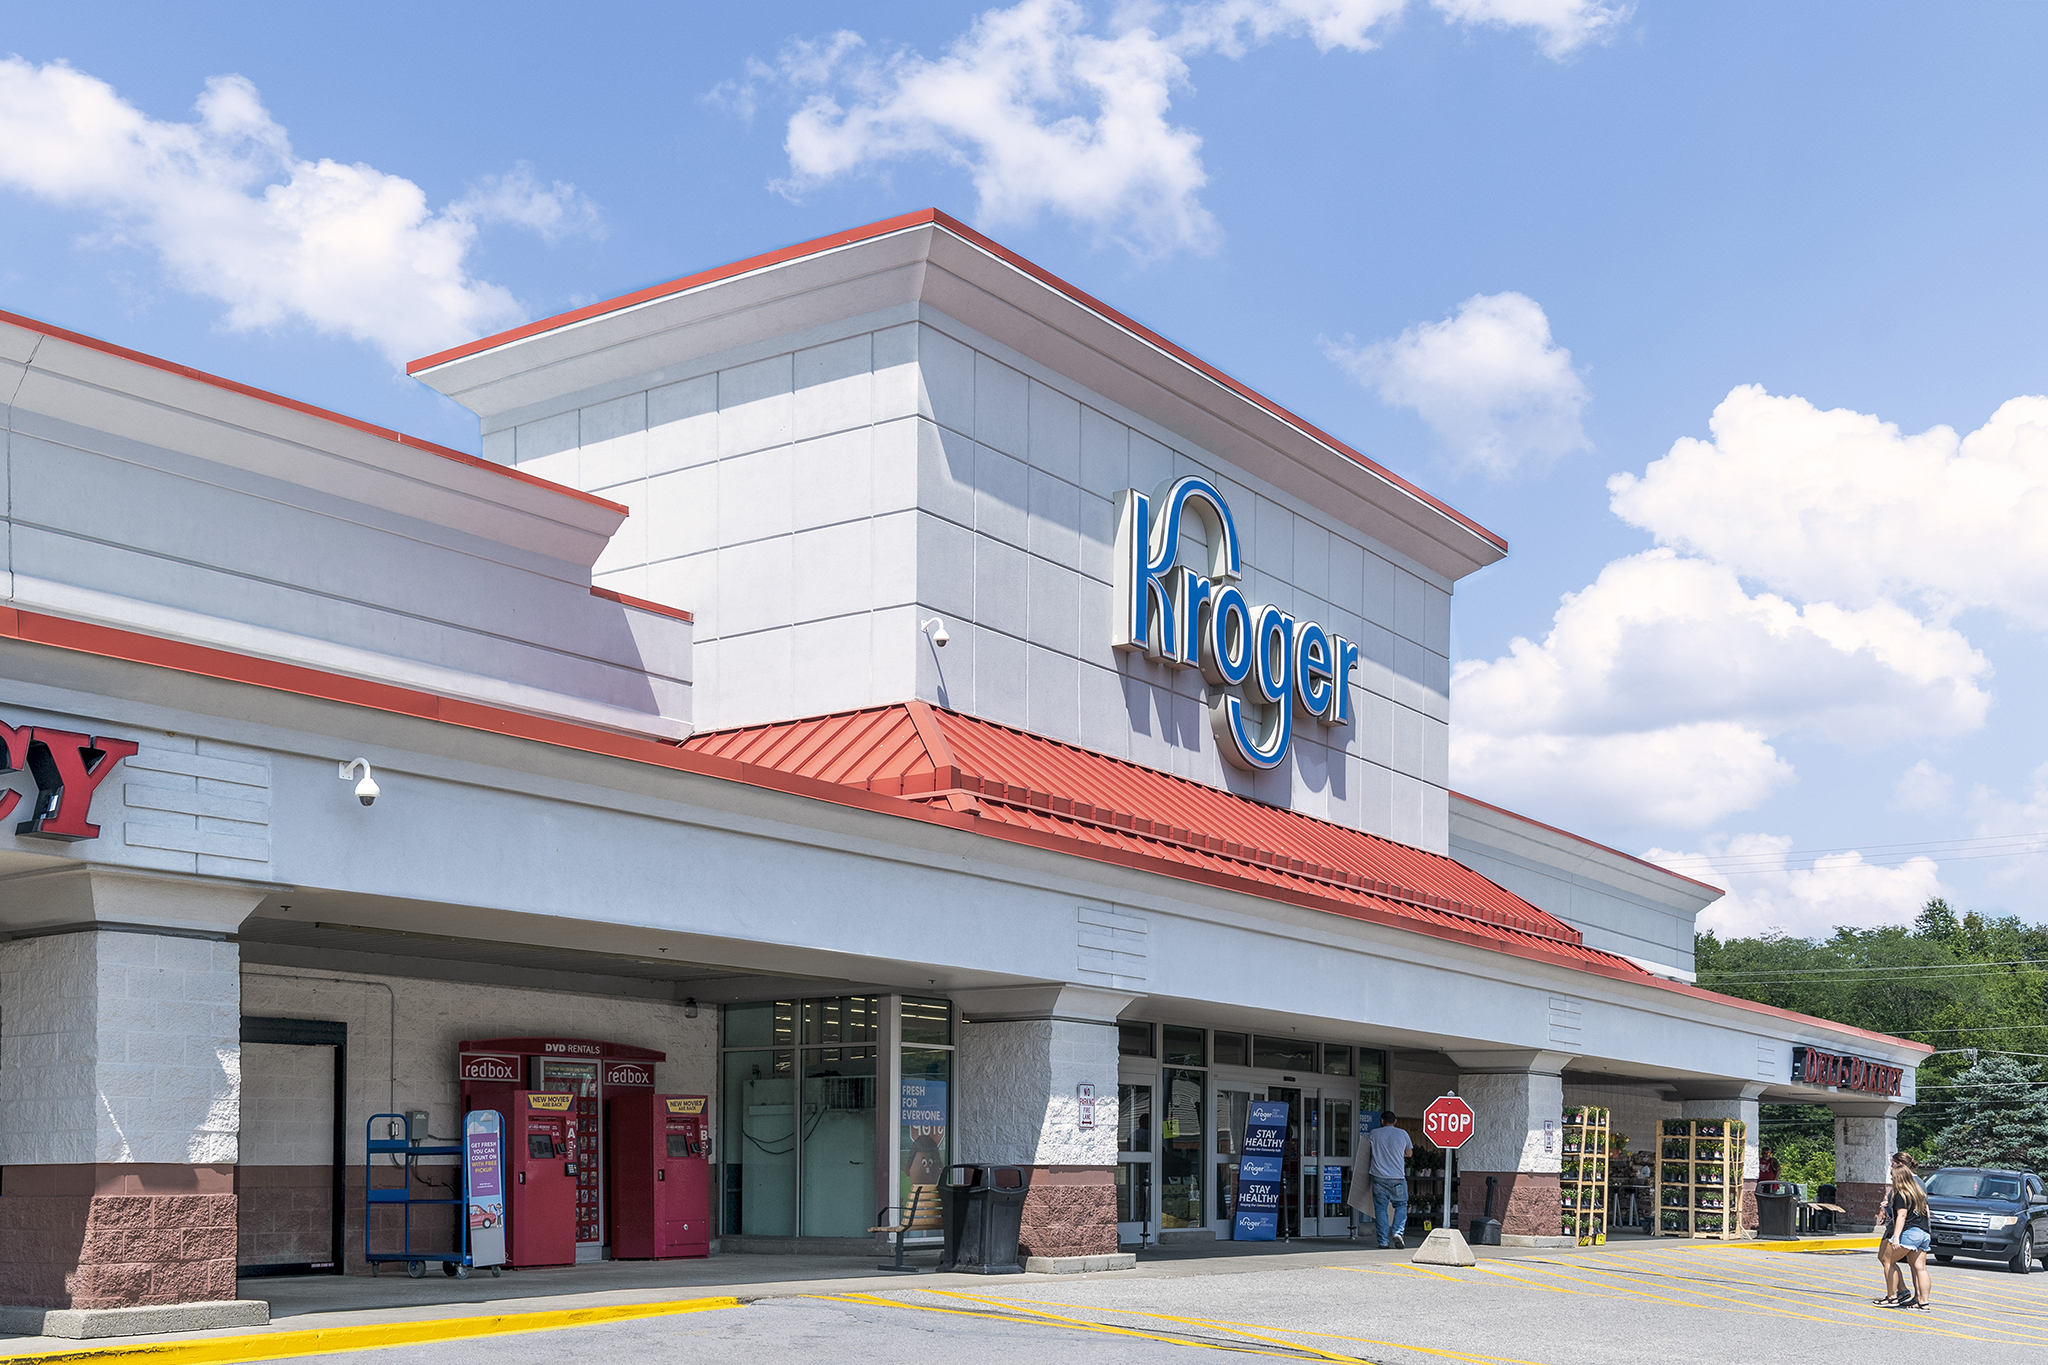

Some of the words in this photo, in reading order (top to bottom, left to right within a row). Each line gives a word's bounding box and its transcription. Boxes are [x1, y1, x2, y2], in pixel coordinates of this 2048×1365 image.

[1112, 475, 1358, 771] Kroger
[545, 1043, 566, 1052] DVD
[567, 1044, 600, 1054] RENTALS
[465, 1061, 513, 1078] redbox
[608, 1065, 650, 1084] redbox
[1803, 1047, 1844, 1087] DELI
[1850, 1056, 1904, 1097] BAKERY
[902, 1085, 926, 1096] FRESH
[1083, 1088, 1090, 1097] NO
[902, 1097, 918, 1108] FOR
[1253, 1108, 1272, 1122] Kroger
[1427, 1112, 1470, 1132] STOP
[567, 1128, 576, 1139] A
[700, 1130, 708, 1140] B
[1256, 1130, 1277, 1138] STAY
[1245, 1138, 1284, 1148] HEALTHY
[1244, 1162, 1264, 1176] Kroger
[1250, 1184, 1270, 1194] STAY
[1239, 1194, 1278, 1203] HEALTHY
[1240, 1216, 1260, 1230] Kroger
